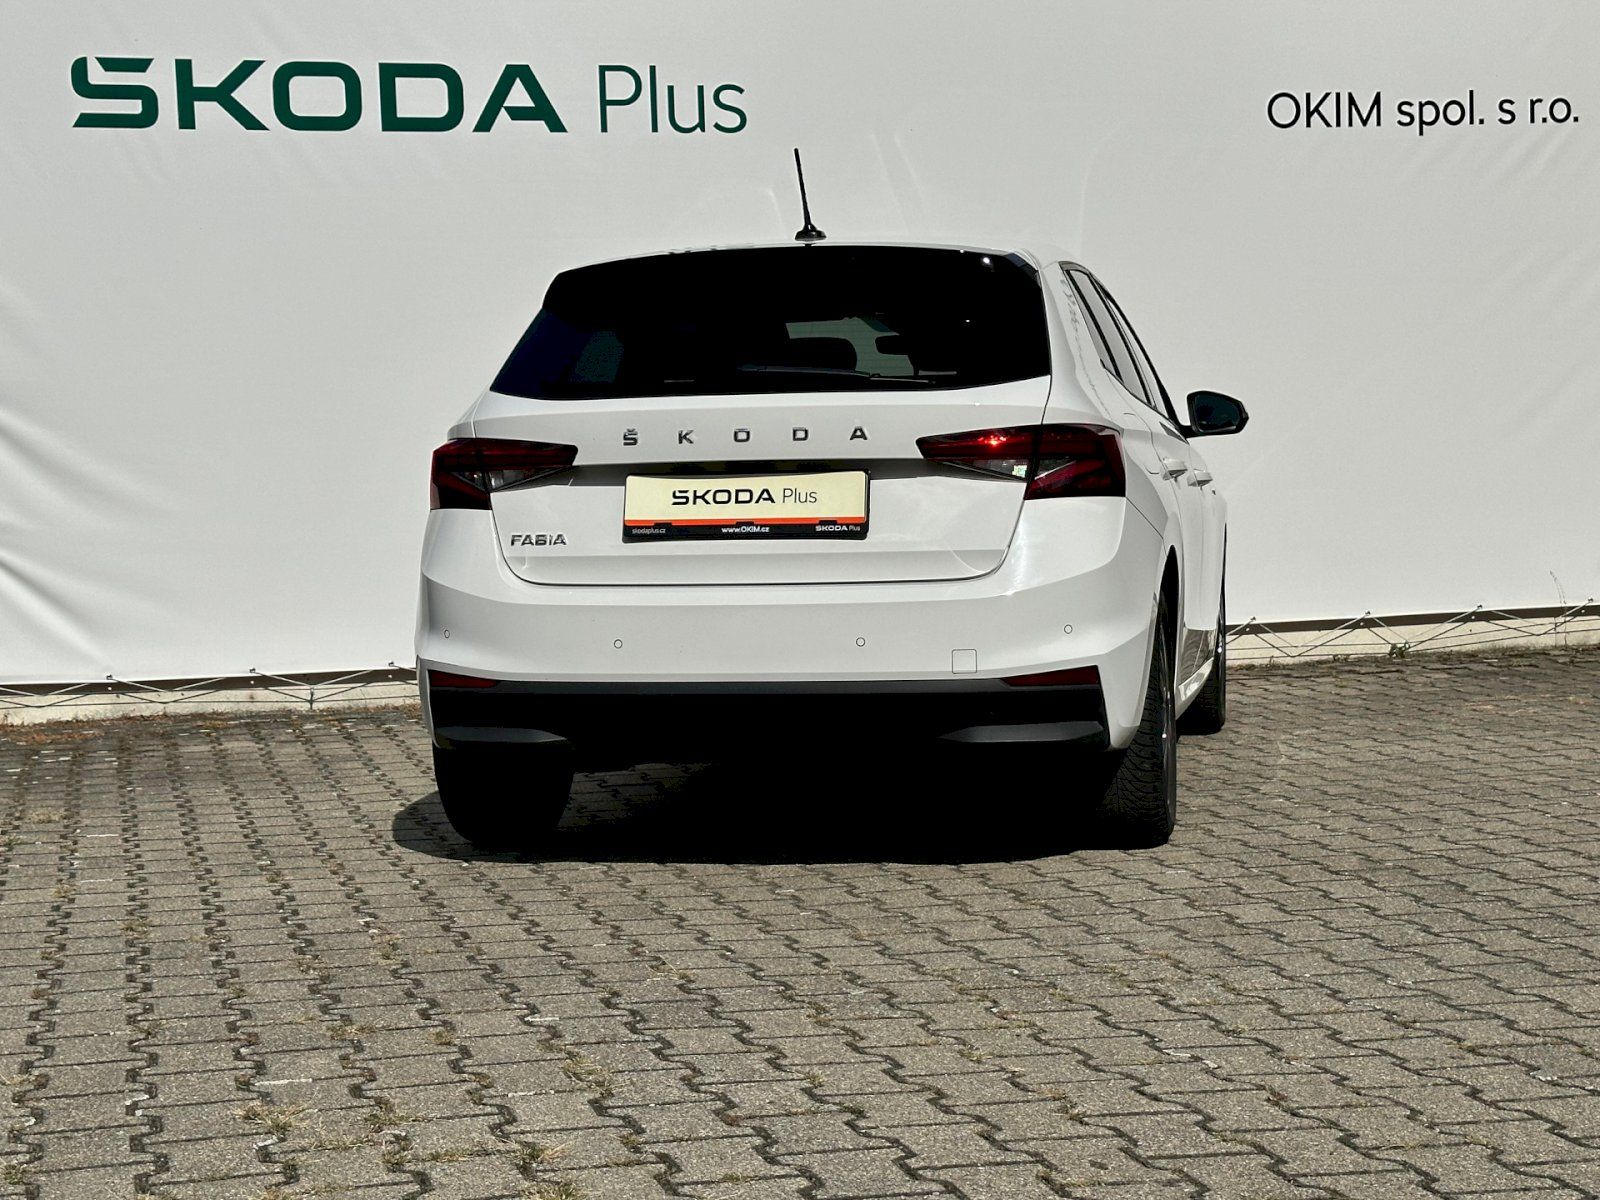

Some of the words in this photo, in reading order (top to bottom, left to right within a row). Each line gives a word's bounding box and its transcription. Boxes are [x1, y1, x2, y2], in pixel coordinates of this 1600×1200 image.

[598, 64, 748, 134] Plus
[1267, 91, 1382, 129] OKIM
[1397, 89, 1485, 136] spol.
[1498, 97, 1516, 125] s
[1529, 96, 1580, 124] r.o.
[782, 487, 818, 504] Plus
[721, 525, 770, 534] www.OKIM.cz
[848, 524, 861, 532] Plus
[510, 533, 567, 546] FABIA
